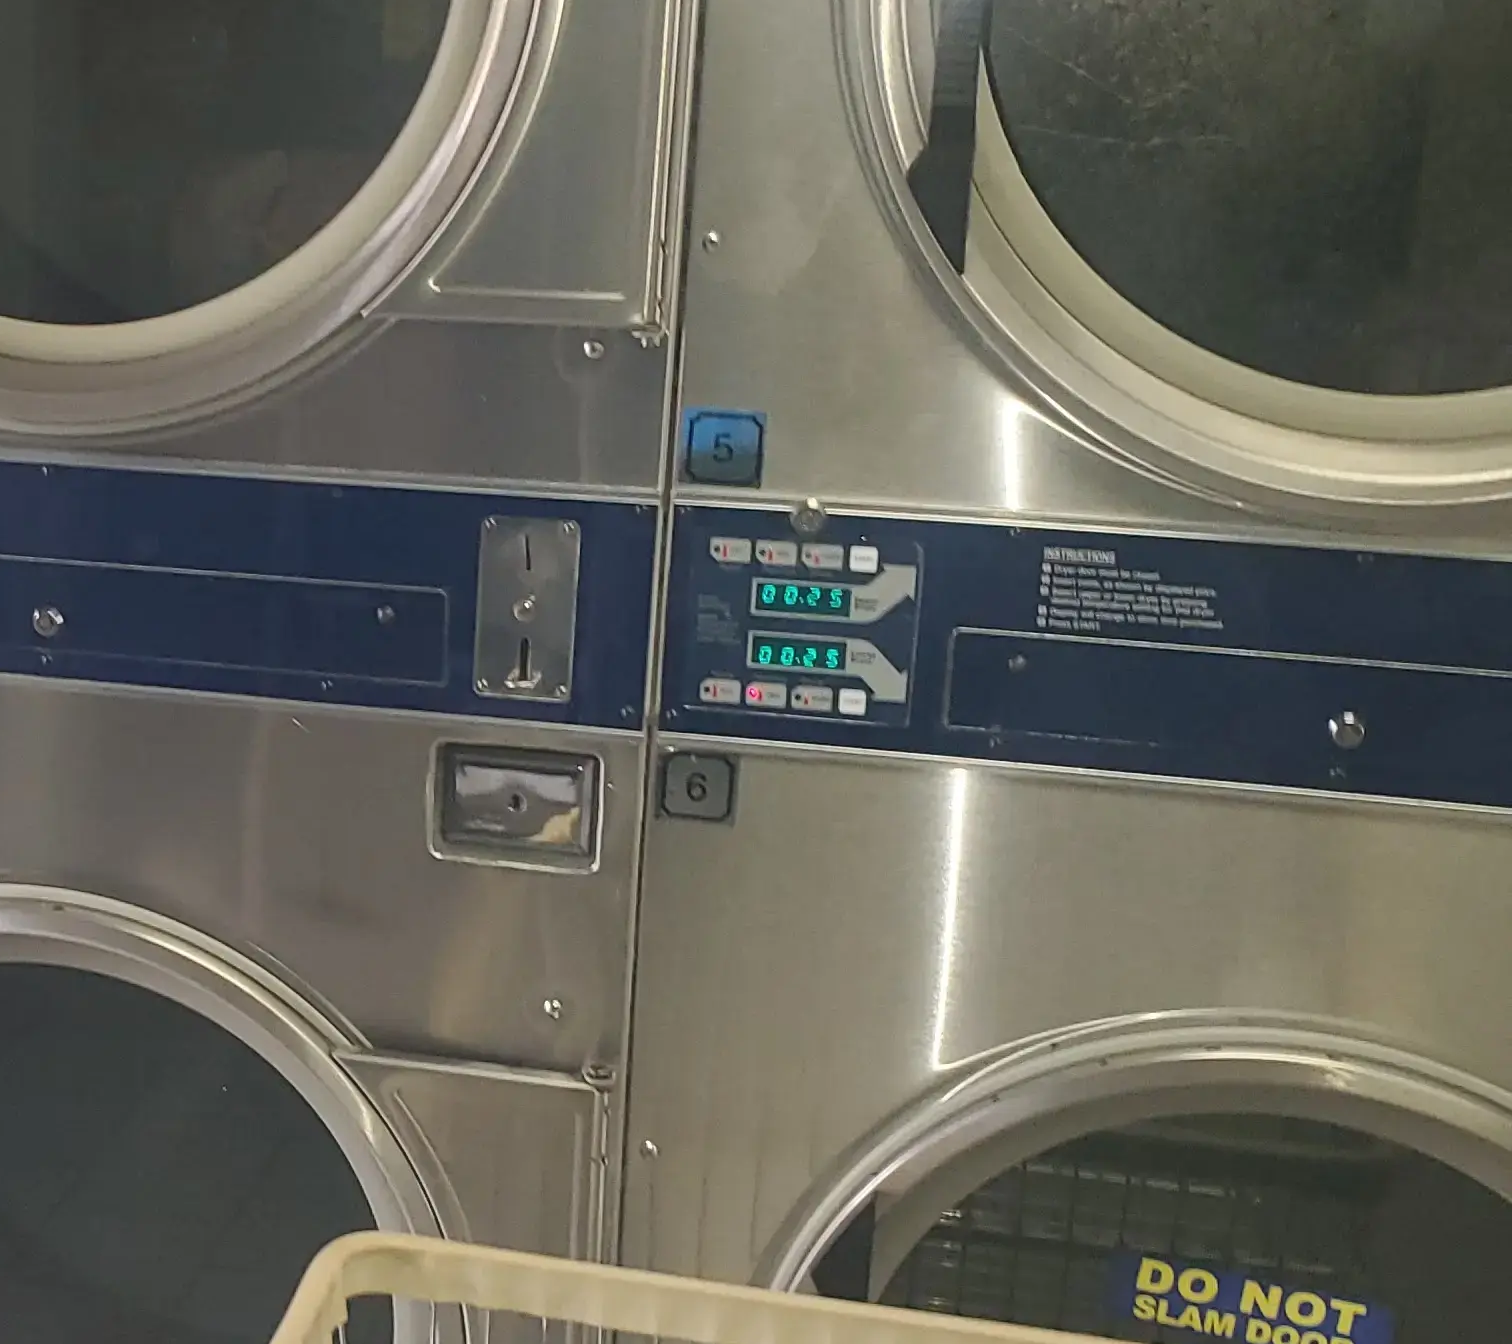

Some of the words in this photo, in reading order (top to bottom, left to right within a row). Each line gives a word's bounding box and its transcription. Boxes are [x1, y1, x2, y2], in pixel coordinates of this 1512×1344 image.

[711, 434, 734, 464] 5
[686, 772, 709, 803] 6
[1136, 1256, 1219, 1304] DO
[1239, 1279, 1368, 1336] NOT
[1133, 1294, 1237, 1339] SLAM
